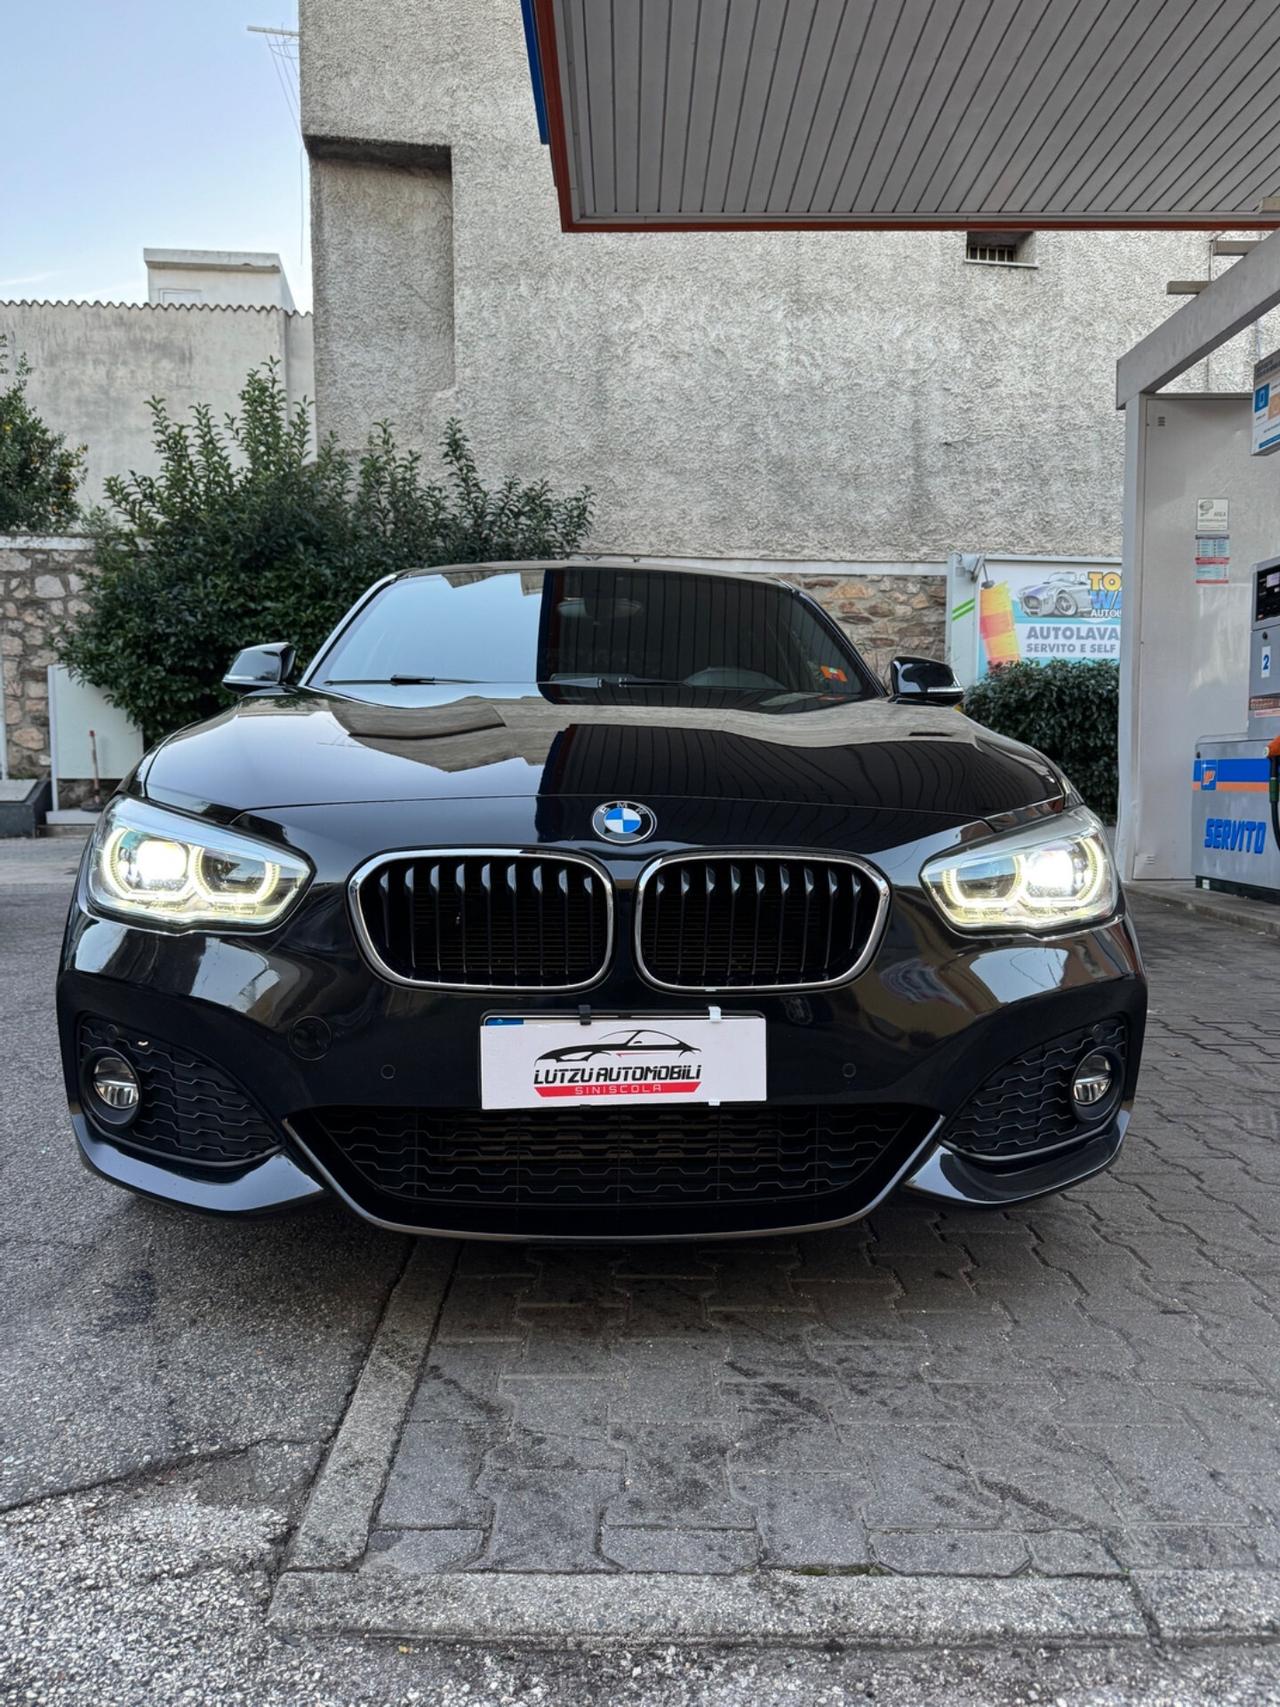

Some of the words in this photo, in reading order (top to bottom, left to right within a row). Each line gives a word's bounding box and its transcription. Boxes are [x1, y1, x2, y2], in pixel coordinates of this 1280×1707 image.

[1026, 626, 1119, 641] AUTOLAVA
[1026, 643, 1076, 653] SERVITO
[1080, 643, 1087, 653] E
[1090, 643, 1116, 653] SELF
[1263, 654, 1270, 670] 2
[1204, 818, 1267, 854] SERVITO
[534, 1068, 594, 1085] LUTZU
[596, 1064, 702, 1082] AUTOMOBILI
[575, 1083, 662, 1095] SINISCOLA
